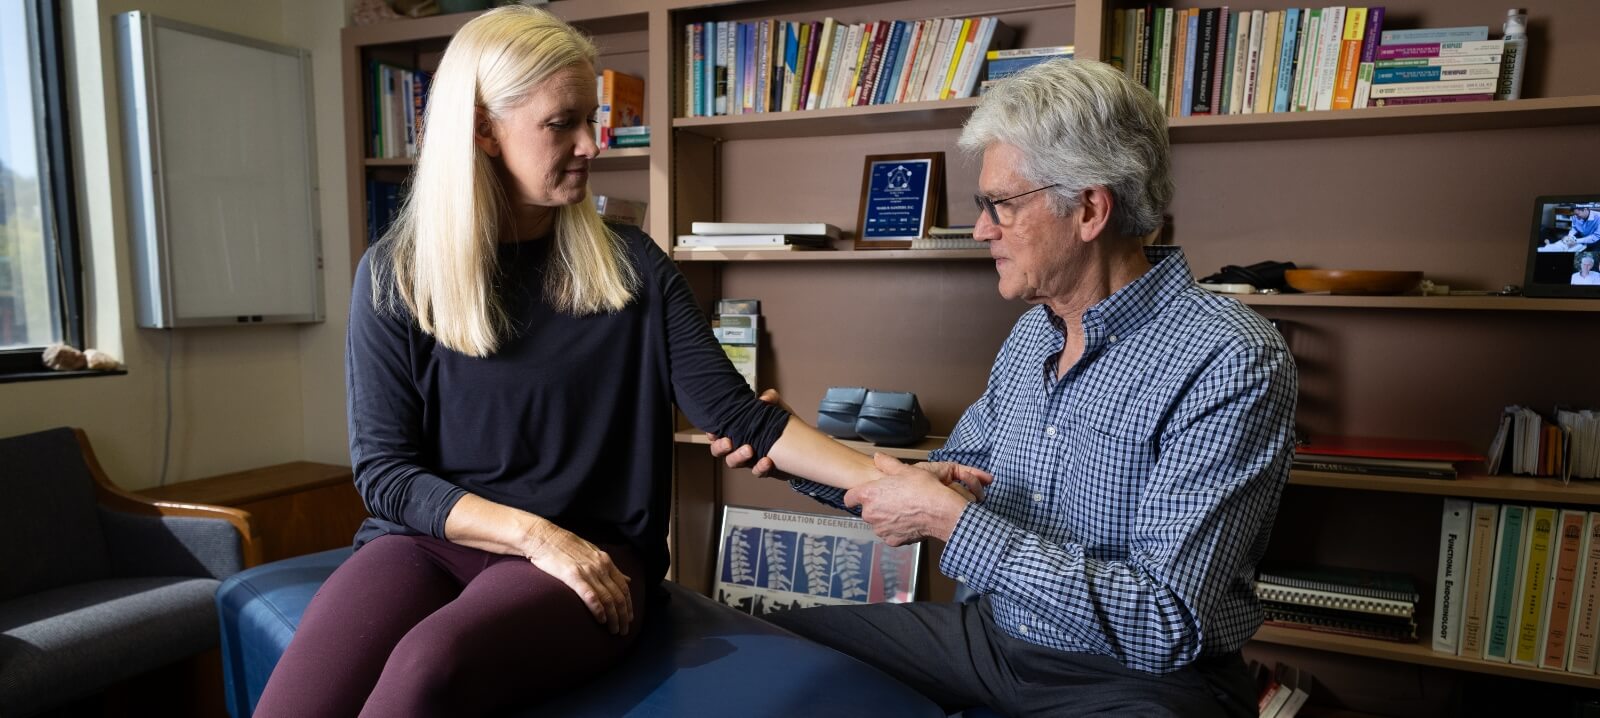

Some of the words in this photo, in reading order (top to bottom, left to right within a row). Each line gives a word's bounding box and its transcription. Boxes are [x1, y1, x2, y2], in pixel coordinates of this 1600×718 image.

[1204, 42, 1210, 52] MY
[866, 54, 880, 80] Healing
[1501, 48, 1517, 95] BIOFREEZE
[861, 80, 873, 100] Heart
[1200, 71, 1208, 102] WORKING?
[763, 512, 815, 525] SUBLUXATION
[817, 518, 873, 530] DEGENERATIO
[1446, 533, 1457, 577] FUNCTIONAL
[1441, 580, 1453, 640] ENDOCRINOLOGY
